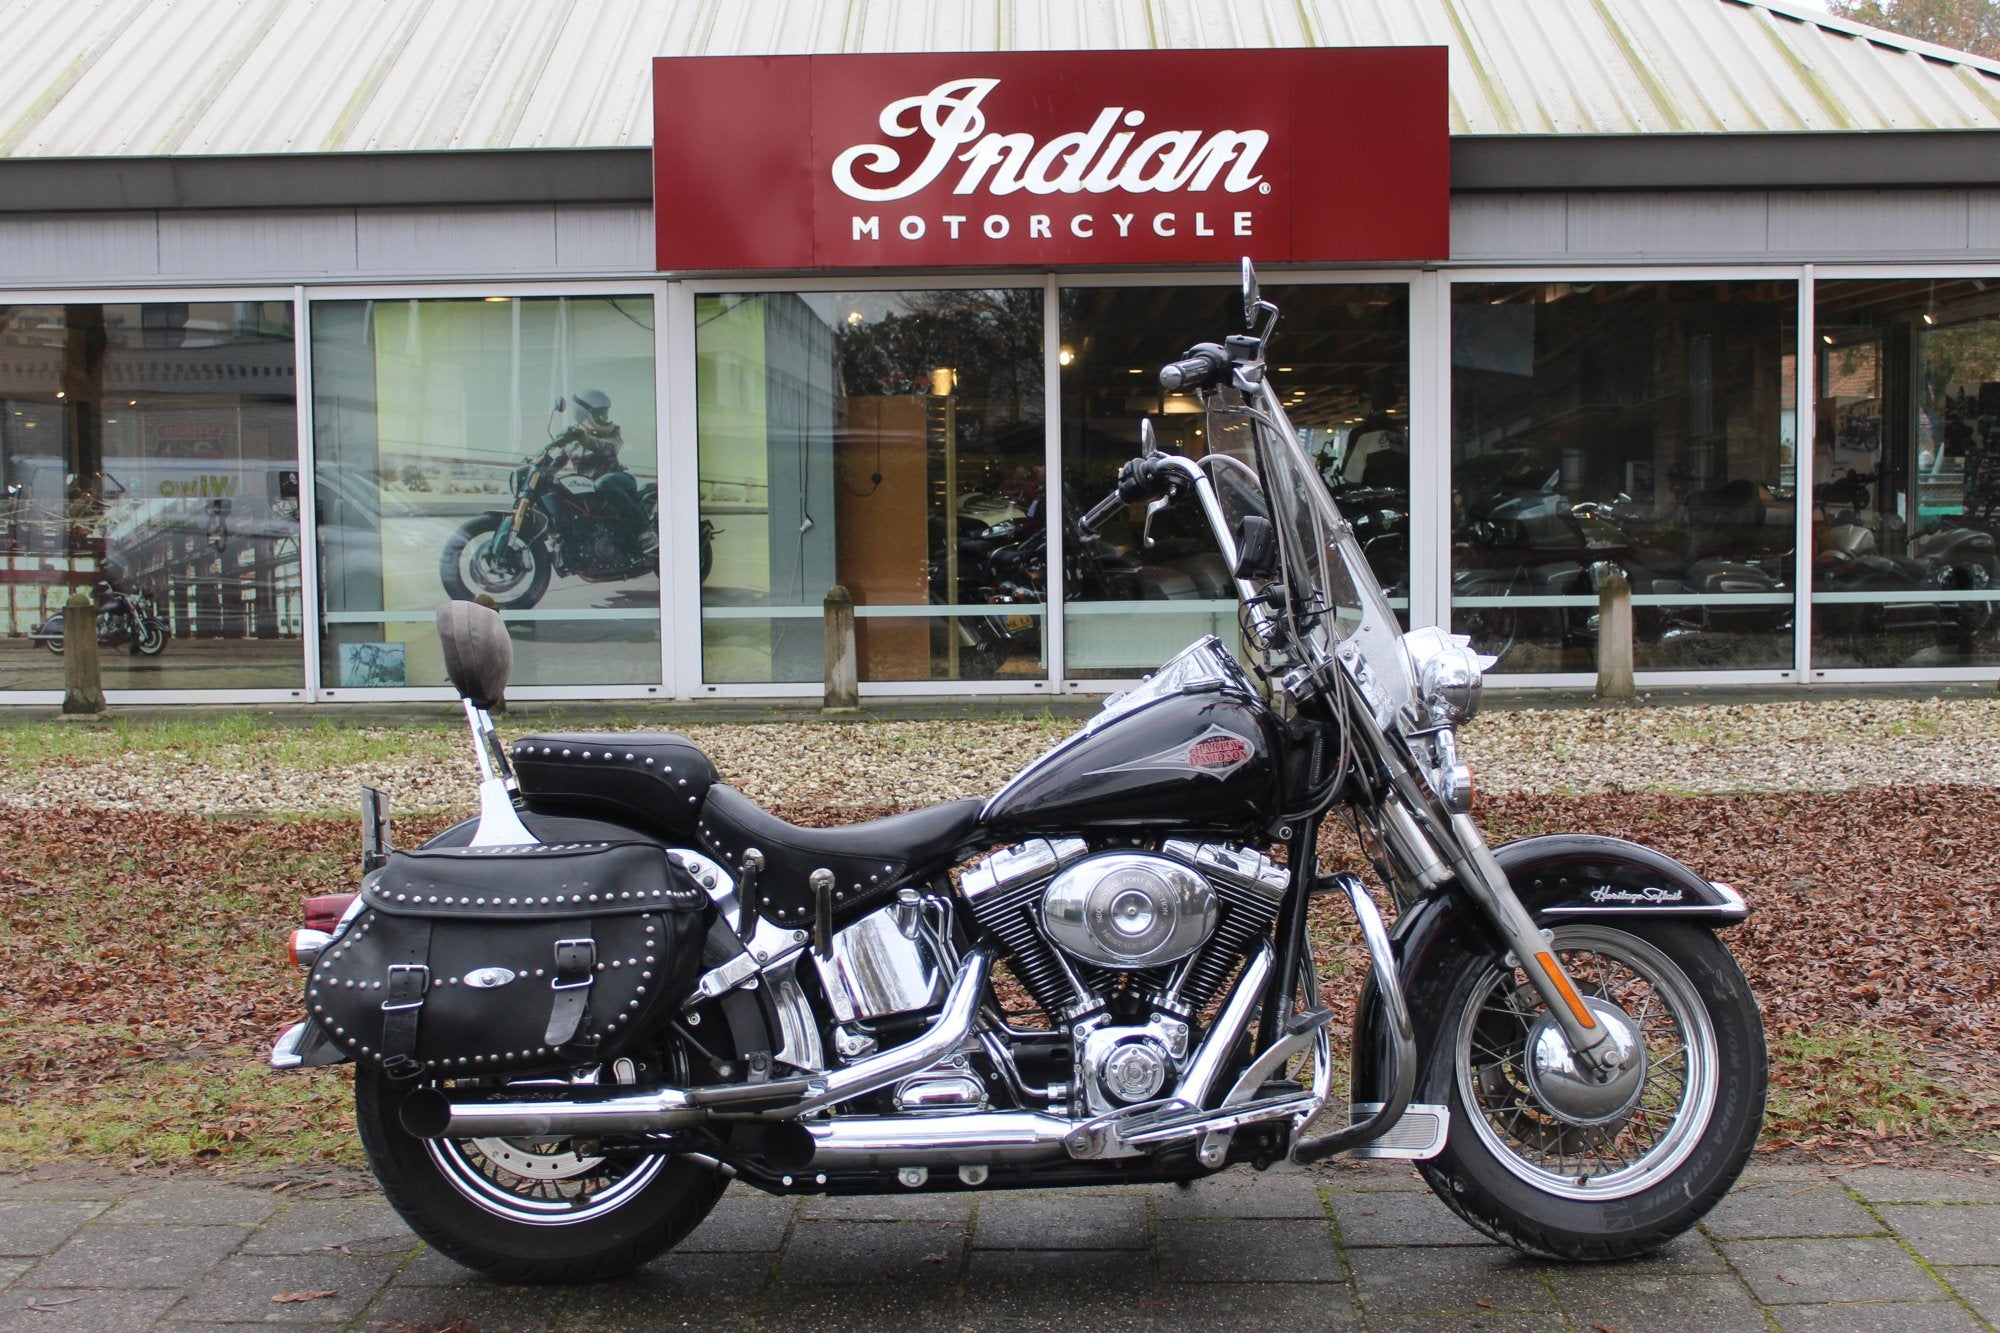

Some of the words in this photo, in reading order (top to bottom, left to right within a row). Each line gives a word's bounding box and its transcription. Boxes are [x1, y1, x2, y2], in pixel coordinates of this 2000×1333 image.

[832, 78, 1270, 201] Indian
[853, 212, 1253, 241] MOTORCYCLE
[1190, 750, 1248, 767] DAVIDSON
[1590, 885, 1644, 904] Heritage
[1643, 887, 1683, 904] Softail
[1712, 1075, 1740, 1144] COBRA
[1642, 1151, 1713, 1211] CHROME
